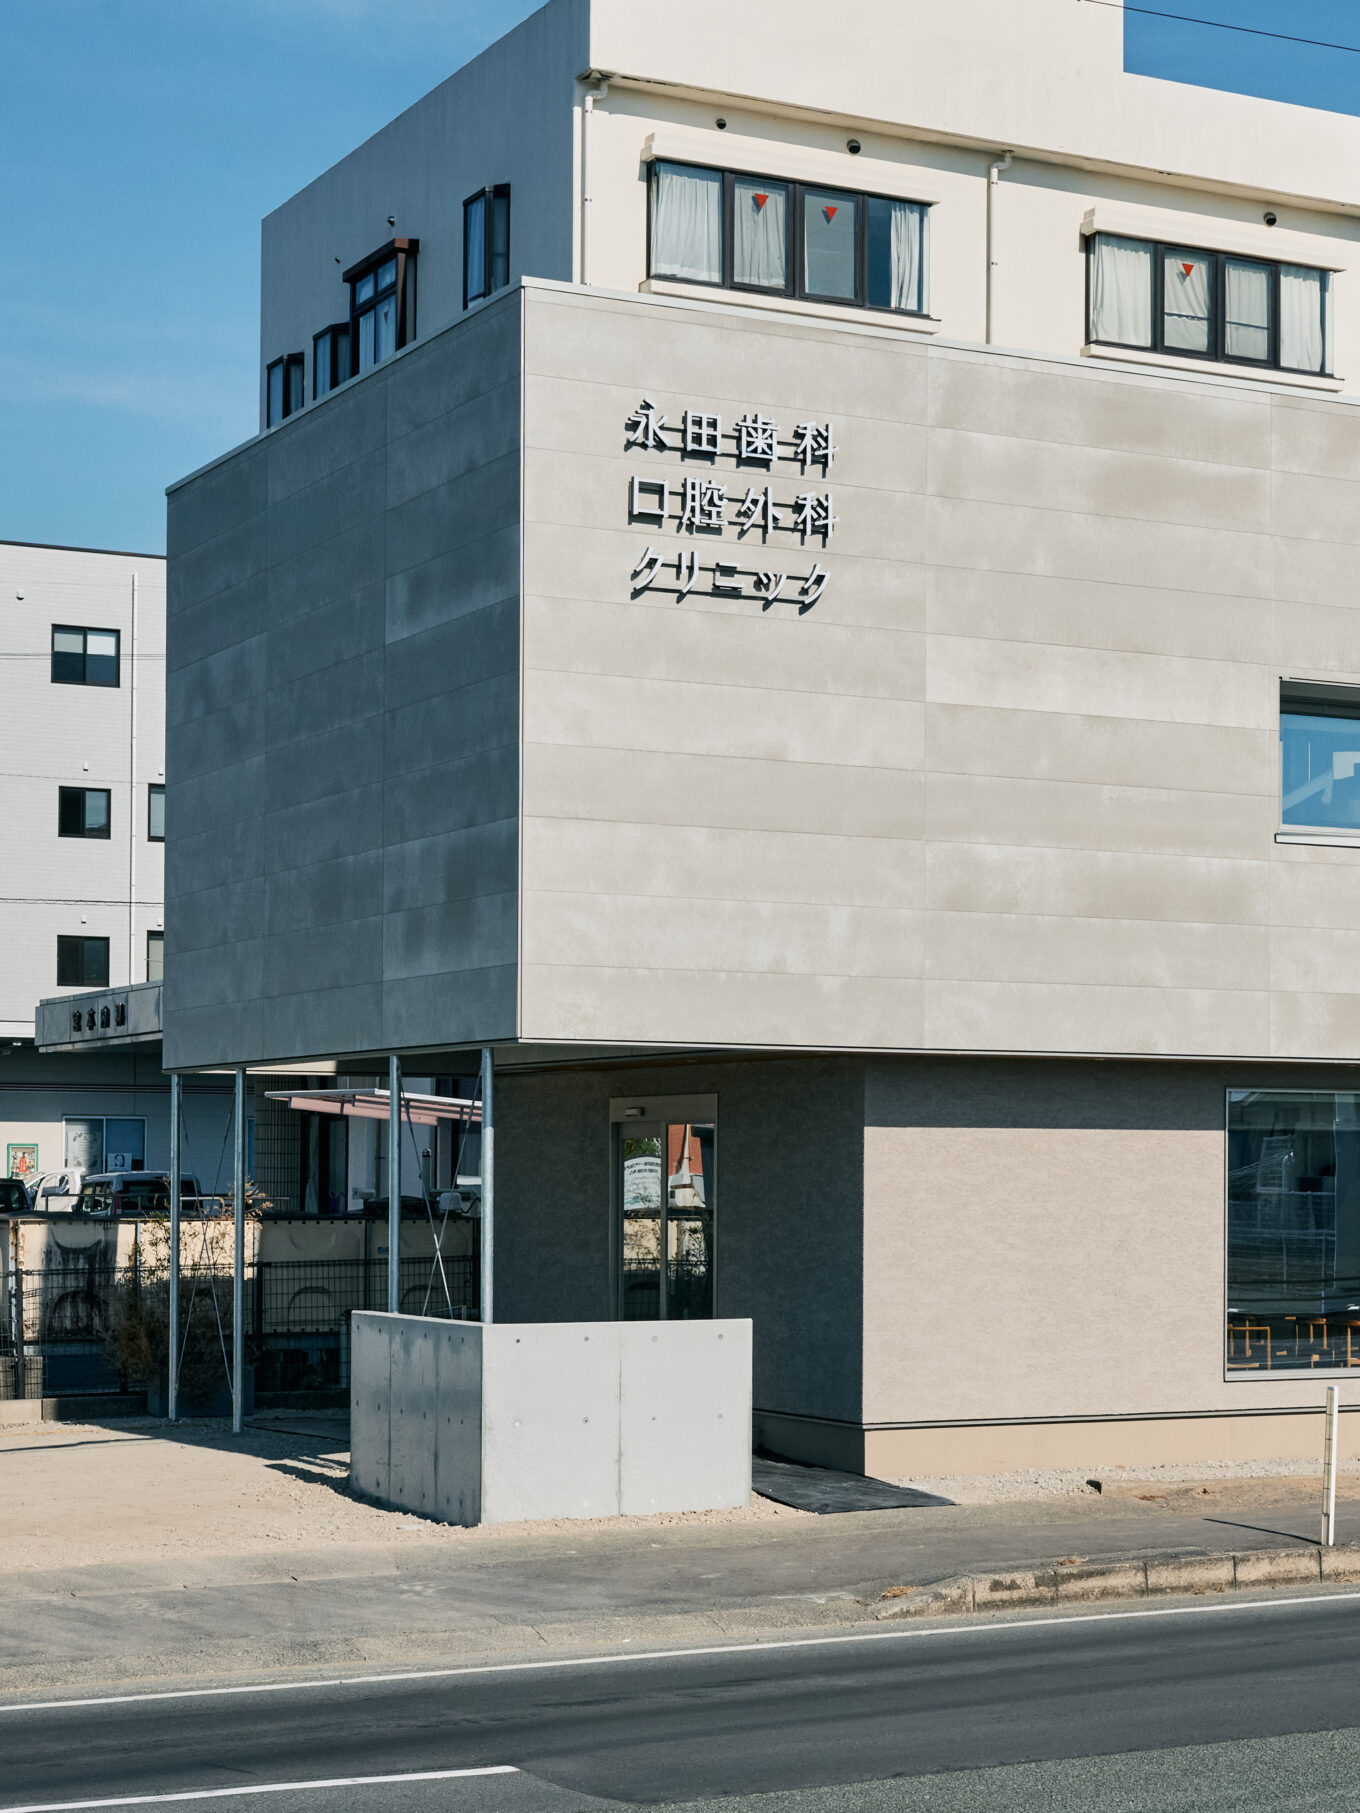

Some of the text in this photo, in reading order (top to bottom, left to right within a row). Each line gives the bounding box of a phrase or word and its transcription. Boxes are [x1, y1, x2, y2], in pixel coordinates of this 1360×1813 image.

[626, 399, 840, 469] 永田歯科
[630, 475, 840, 539] 口腔外科
[631, 546, 832, 605] クリニック
